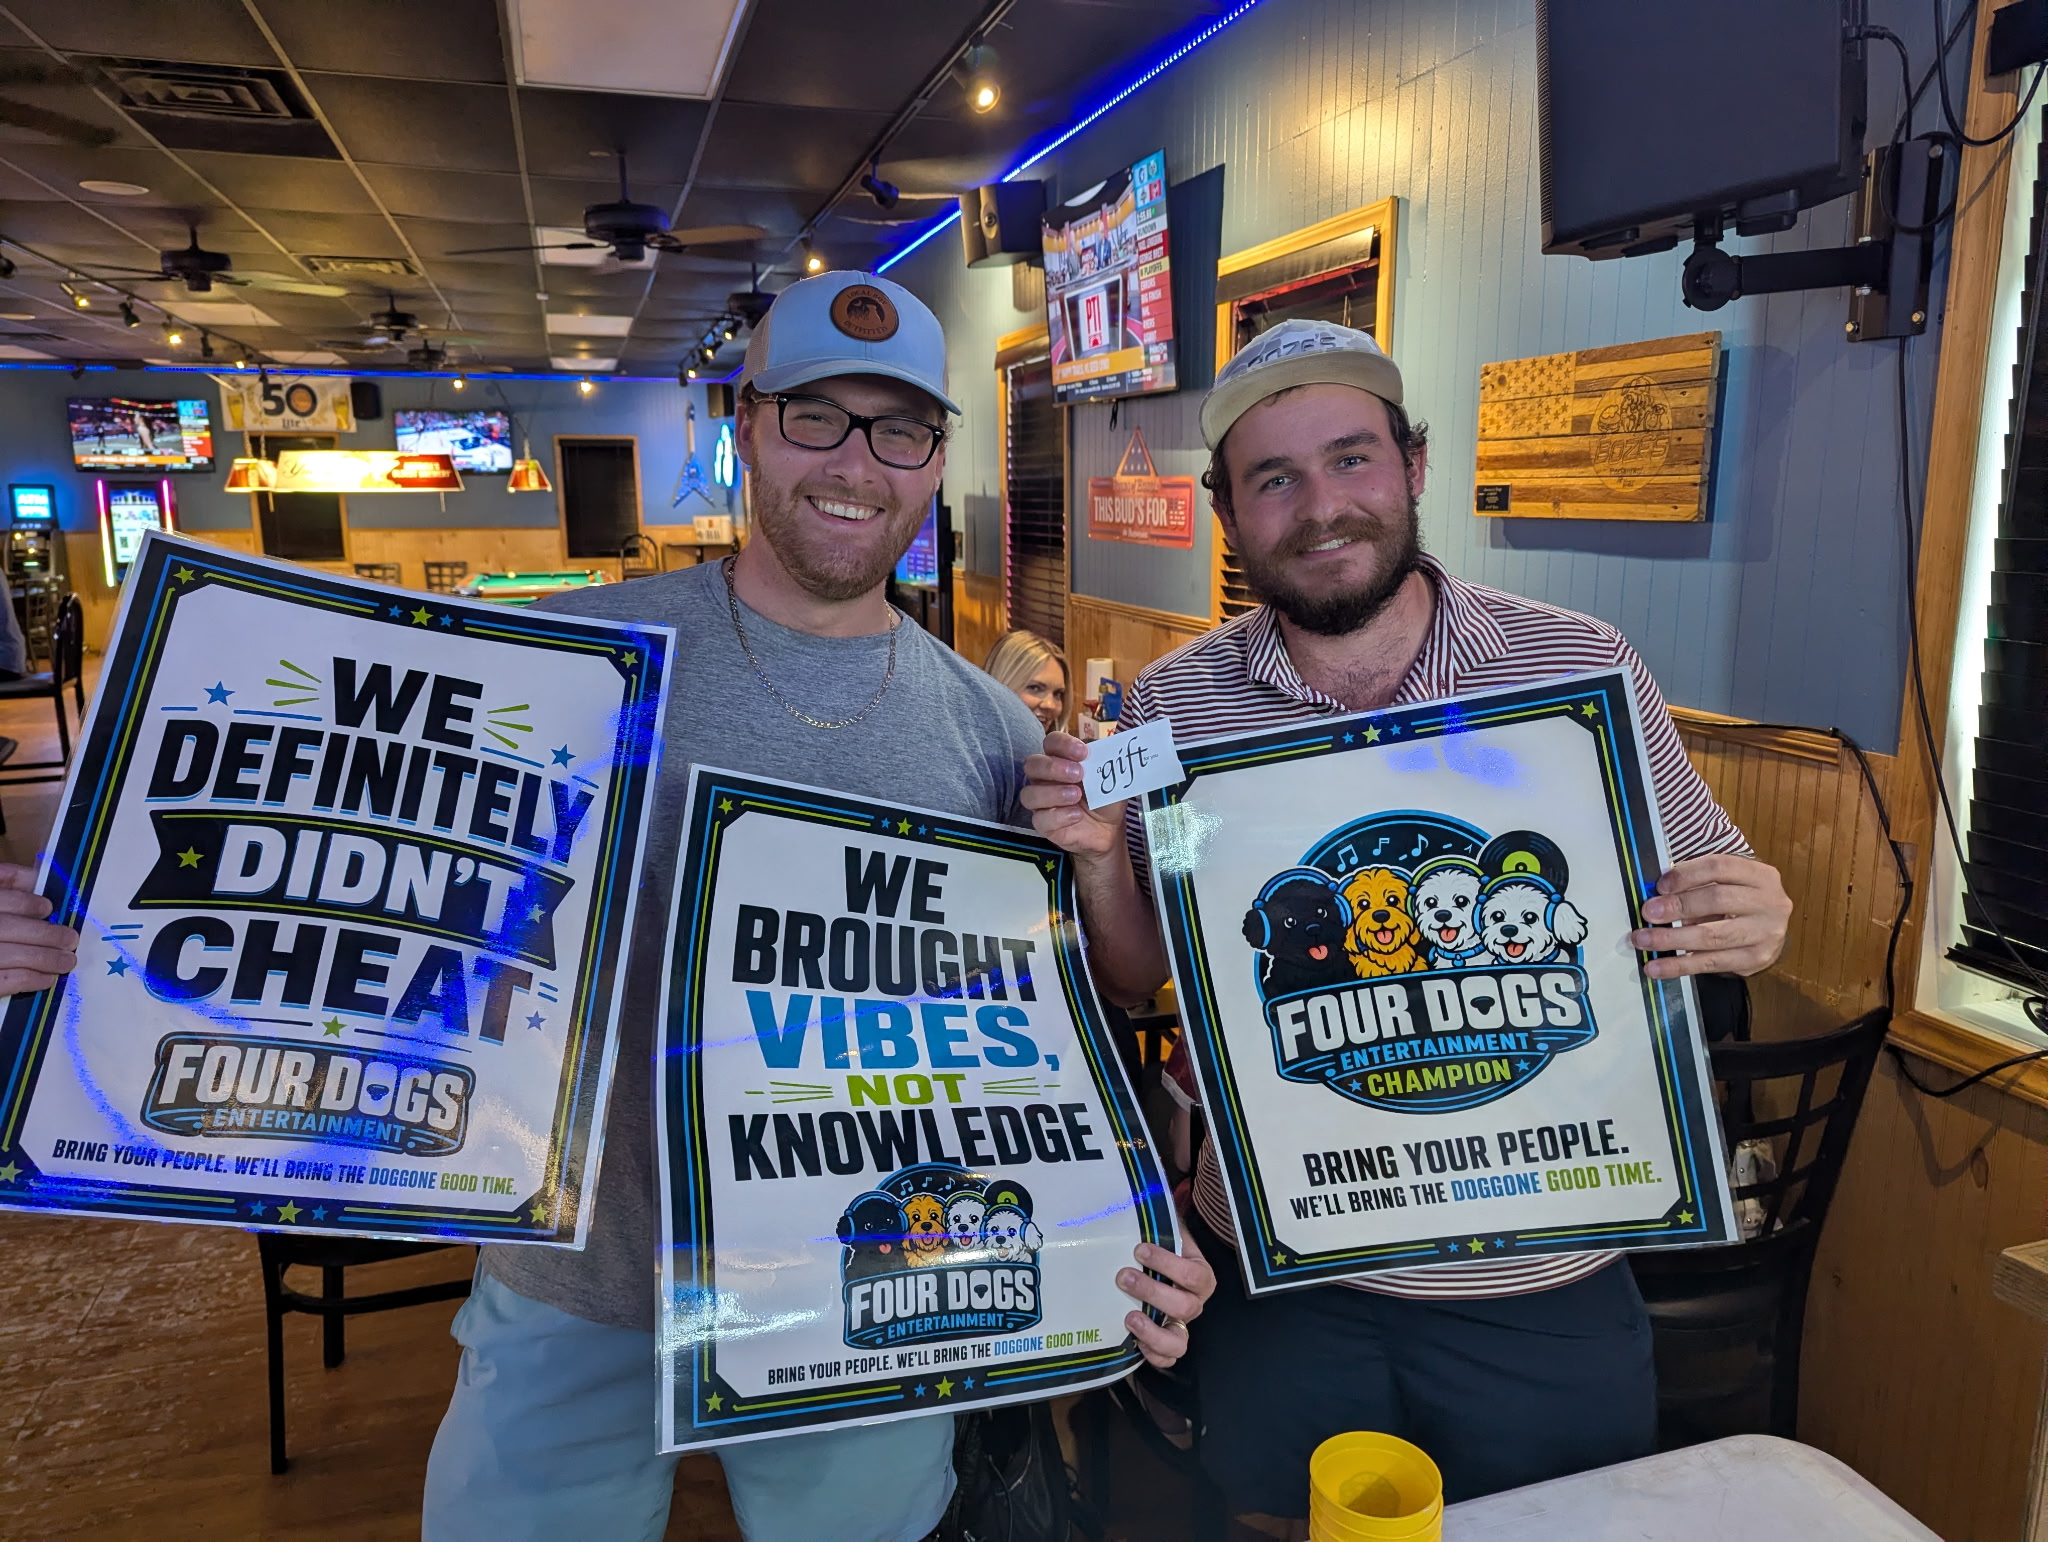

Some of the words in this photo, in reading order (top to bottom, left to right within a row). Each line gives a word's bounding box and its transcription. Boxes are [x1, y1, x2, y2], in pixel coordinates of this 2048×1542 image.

[1138, 222, 1157, 237] RUNDOWN
[847, 290, 870, 299] LOCAL
[1144, 261, 1163, 276] PLAYOFFS
[844, 320, 888, 335] OUTFITTERS
[1085, 295, 1101, 334] PTI
[262, 383, 318, 417] 50
[1094, 496, 1114, 522] THIS
[1114, 497, 1145, 525] BUD'S
[1146, 497, 1168, 527] FOR
[333, 656, 484, 749] WE
[144, 718, 595, 867] DEFINITELY
[1100, 736, 1148, 794] gift
[211, 824, 526, 934] DIDN'T
[844, 846, 949, 925] WE
[143, 916, 534, 1046] CHEAT
[732, 903, 1037, 1002] BROUGHT
[745, 989, 1060, 1072] VIBES,
[1276, 984, 1416, 1062] FOUR
[1421, 972, 1582, 1033] DOGS
[1341, 1032, 1529, 1071] ENTERTAINMENT
[1367, 1059, 1512, 1097] CHAMPION
[158, 1044, 315, 1109] FOUR
[327, 1056, 465, 1131] DOGS
[846, 1073, 967, 1107] NOT
[212, 1107, 406, 1143] ENTERTAINMENT
[727, 1103, 1104, 1181] KNOWLEDGE
[1303, 1144, 1400, 1187] BRING
[1403, 1135, 1492, 1176] YOUR
[1496, 1119, 1630, 1166] PEOPLE.
[52, 1139, 108, 1163] BRING
[112, 1144, 158, 1168] YOUR
[163, 1149, 228, 1174] PEOPLE.
[234, 1155, 280, 1178] WE'LL
[283, 1159, 334, 1182] BRING
[337, 1163, 365, 1184] THE
[368, 1166, 438, 1190] DOGGONE
[439, 1172, 478, 1193] GOOD
[481, 1174, 518, 1196] TIME.
[1290, 1192, 1346, 1220] WE'LL
[1348, 1187, 1408, 1213] BRING
[1410, 1182, 1448, 1206] THE
[1450, 1171, 1542, 1202] DOGGONE
[1546, 1165, 1600, 1192] GOOD
[1604, 1161, 1662, 1187] TIME.
[851, 1274, 940, 1331] FOUR
[947, 1268, 1037, 1311] DOGS
[887, 1313, 1005, 1340] ENTERTAINMENT
[768, 1365, 806, 1385] BRING
[809, 1361, 841, 1380] YOUR
[845, 1355, 893, 1375] PEOPLE.
[897, 1351, 931, 1369] WE'LL
[933, 1345, 969, 1365] BRING
[971, 1342, 991, 1359] THE
[994, 1336, 1044, 1356] DOGGONE
[1046, 1332, 1074, 1349] GOOD
[1076, 1328, 1103, 1345] TIME.
